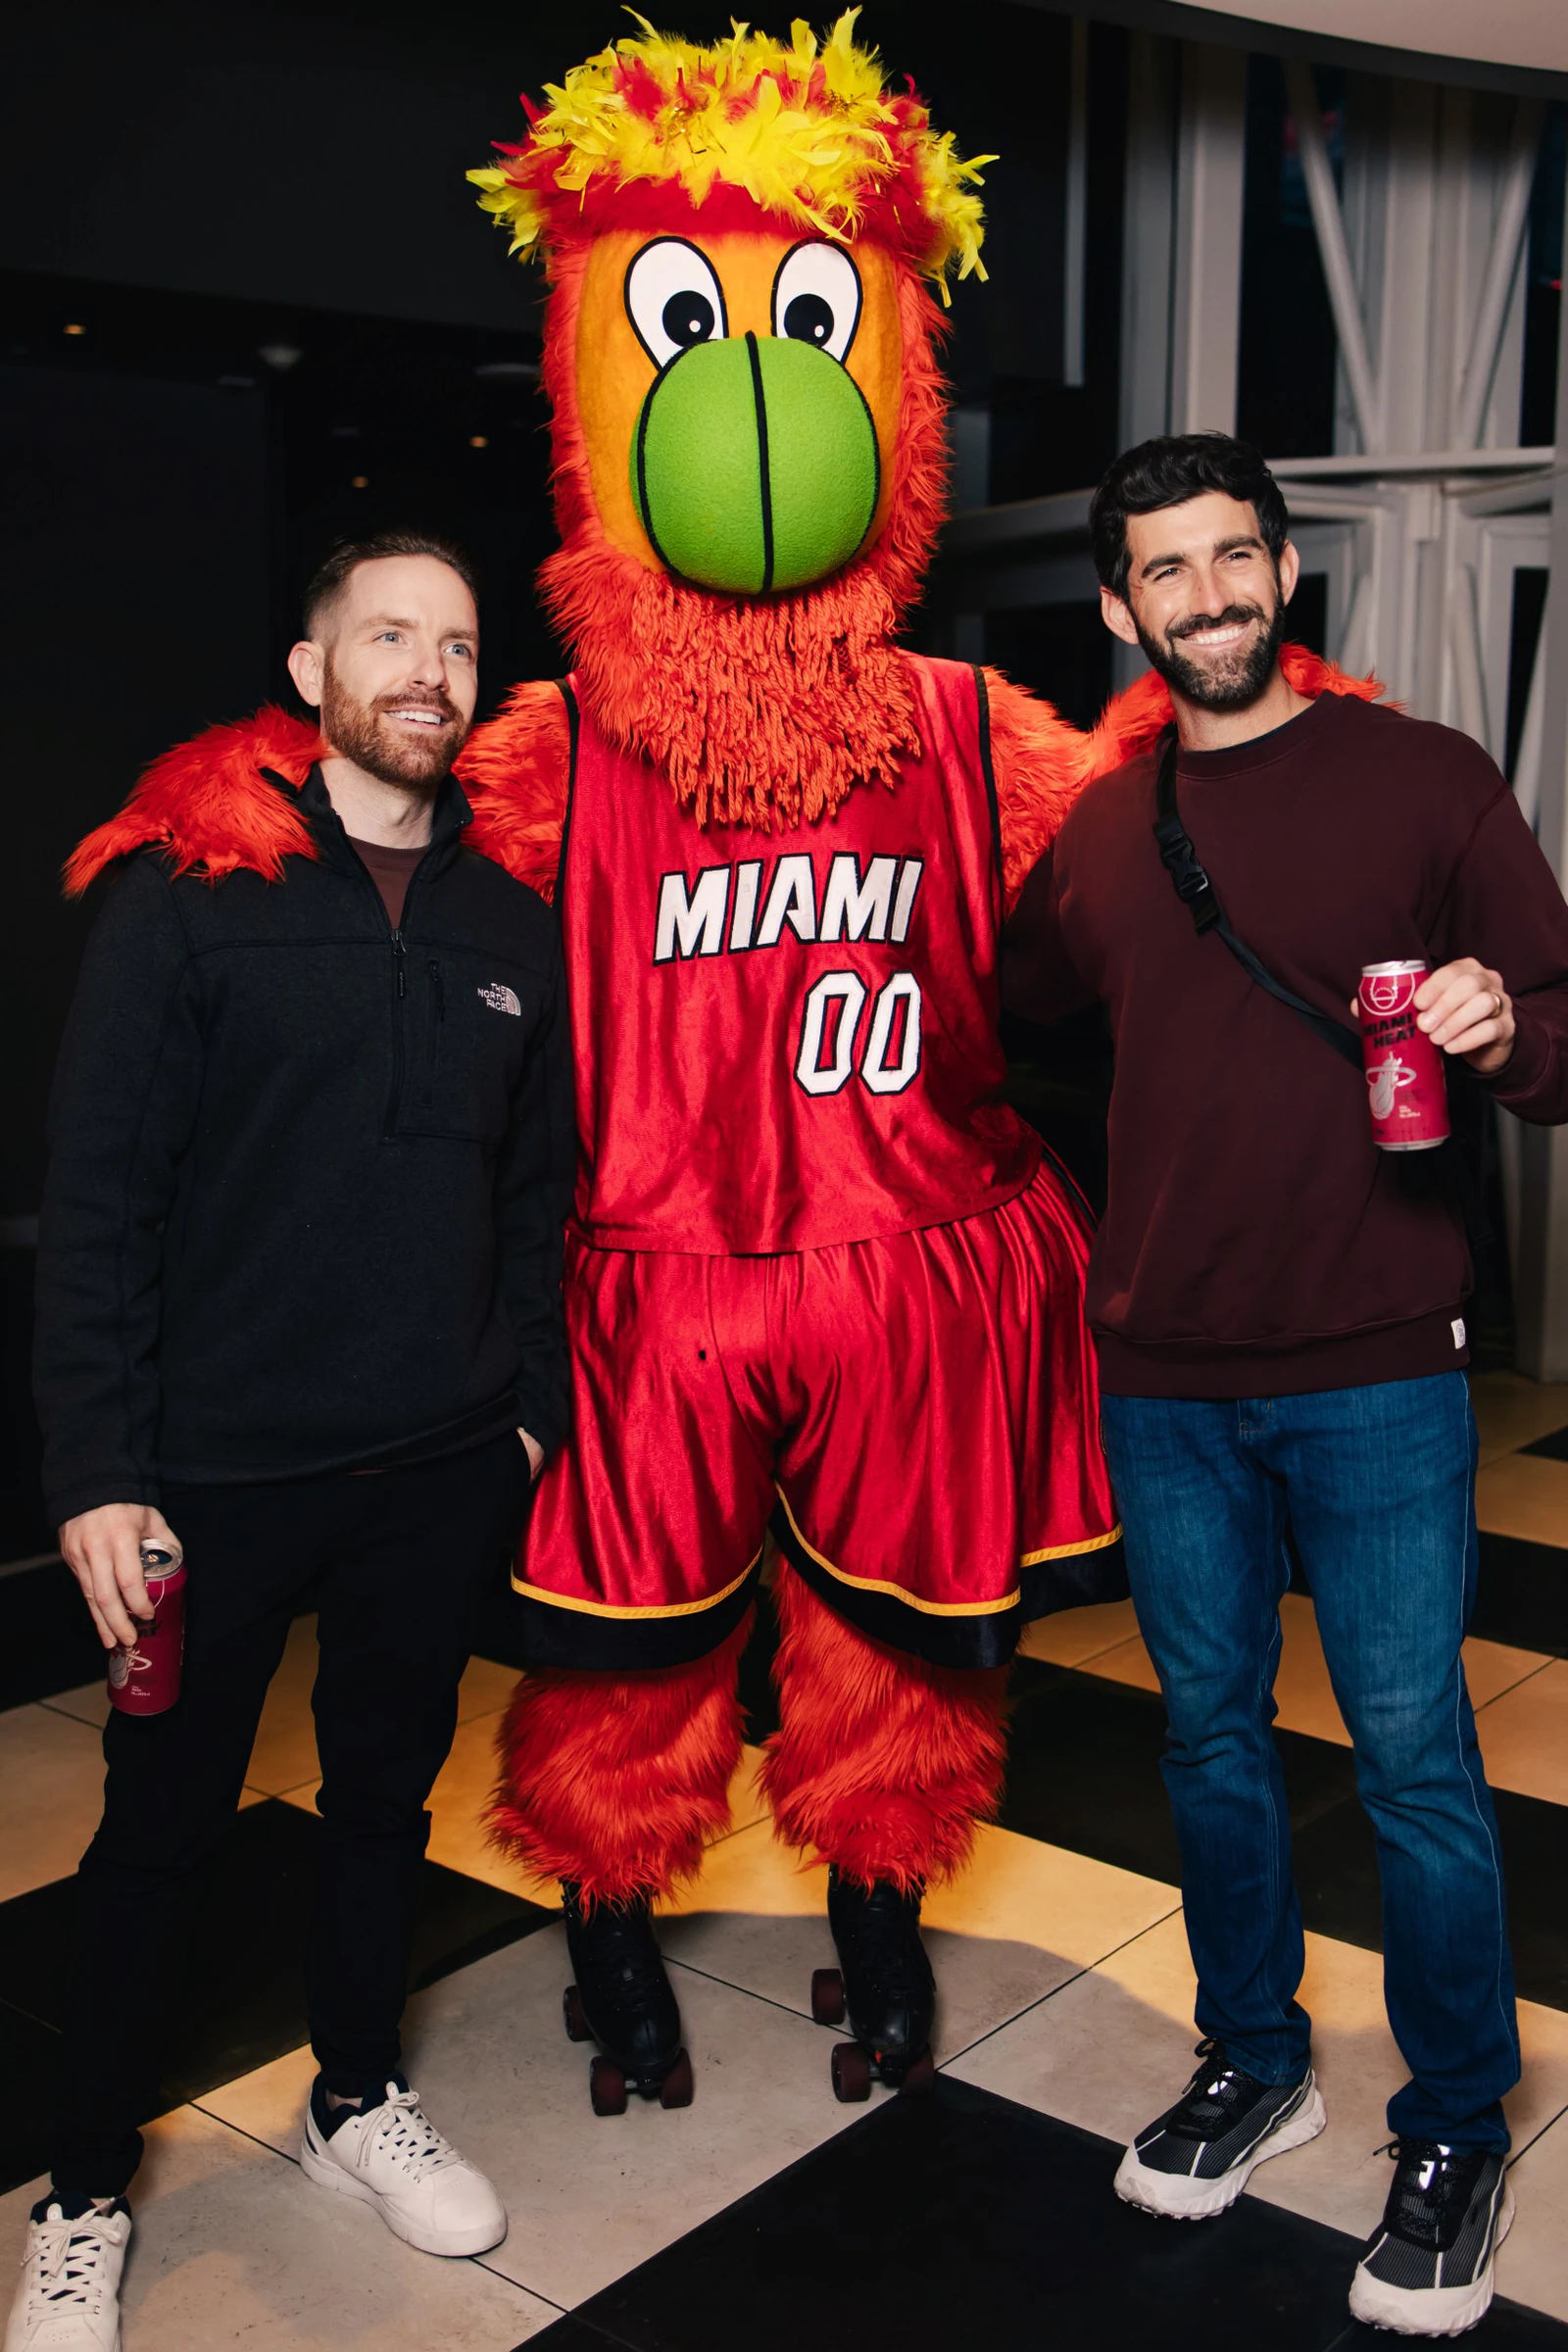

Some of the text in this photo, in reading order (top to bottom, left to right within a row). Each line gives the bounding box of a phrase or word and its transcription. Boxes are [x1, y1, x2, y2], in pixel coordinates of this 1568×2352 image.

[653, 851, 924, 966] MIAMI
[477, 988, 506, 1003] NORTH
[491, 983, 506, 995] THE
[486, 999, 507, 1011] FACE
[794, 969, 921, 1098] 00
[1374, 1026, 1416, 1049] HEAT
